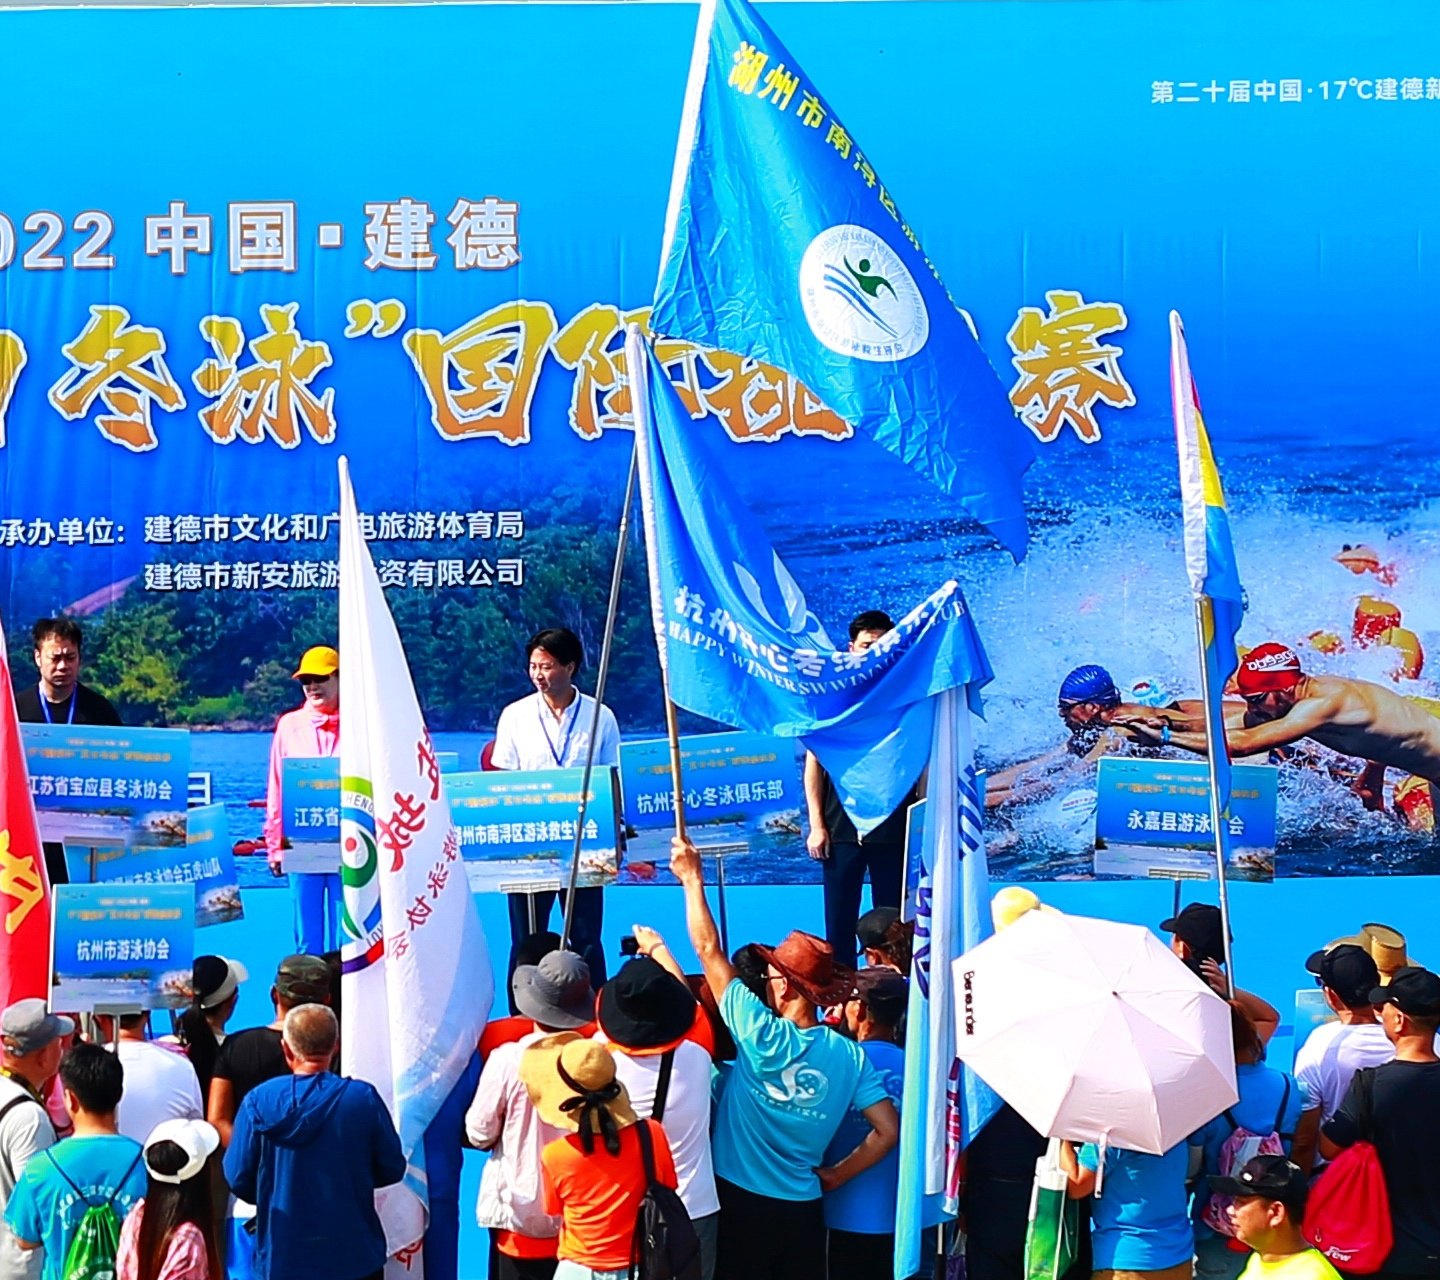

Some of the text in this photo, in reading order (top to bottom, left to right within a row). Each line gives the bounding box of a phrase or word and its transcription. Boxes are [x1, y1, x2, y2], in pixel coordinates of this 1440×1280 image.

[143, 556, 526, 593] 建德市新安旅游资有限公司
[669, 619, 727, 658] HAPPY
[294, 805, 342, 829] 江苏省
[1126, 808, 1246, 836] 永嘉县游泳会
[77, 938, 171, 962] 杭州市游泳协会
